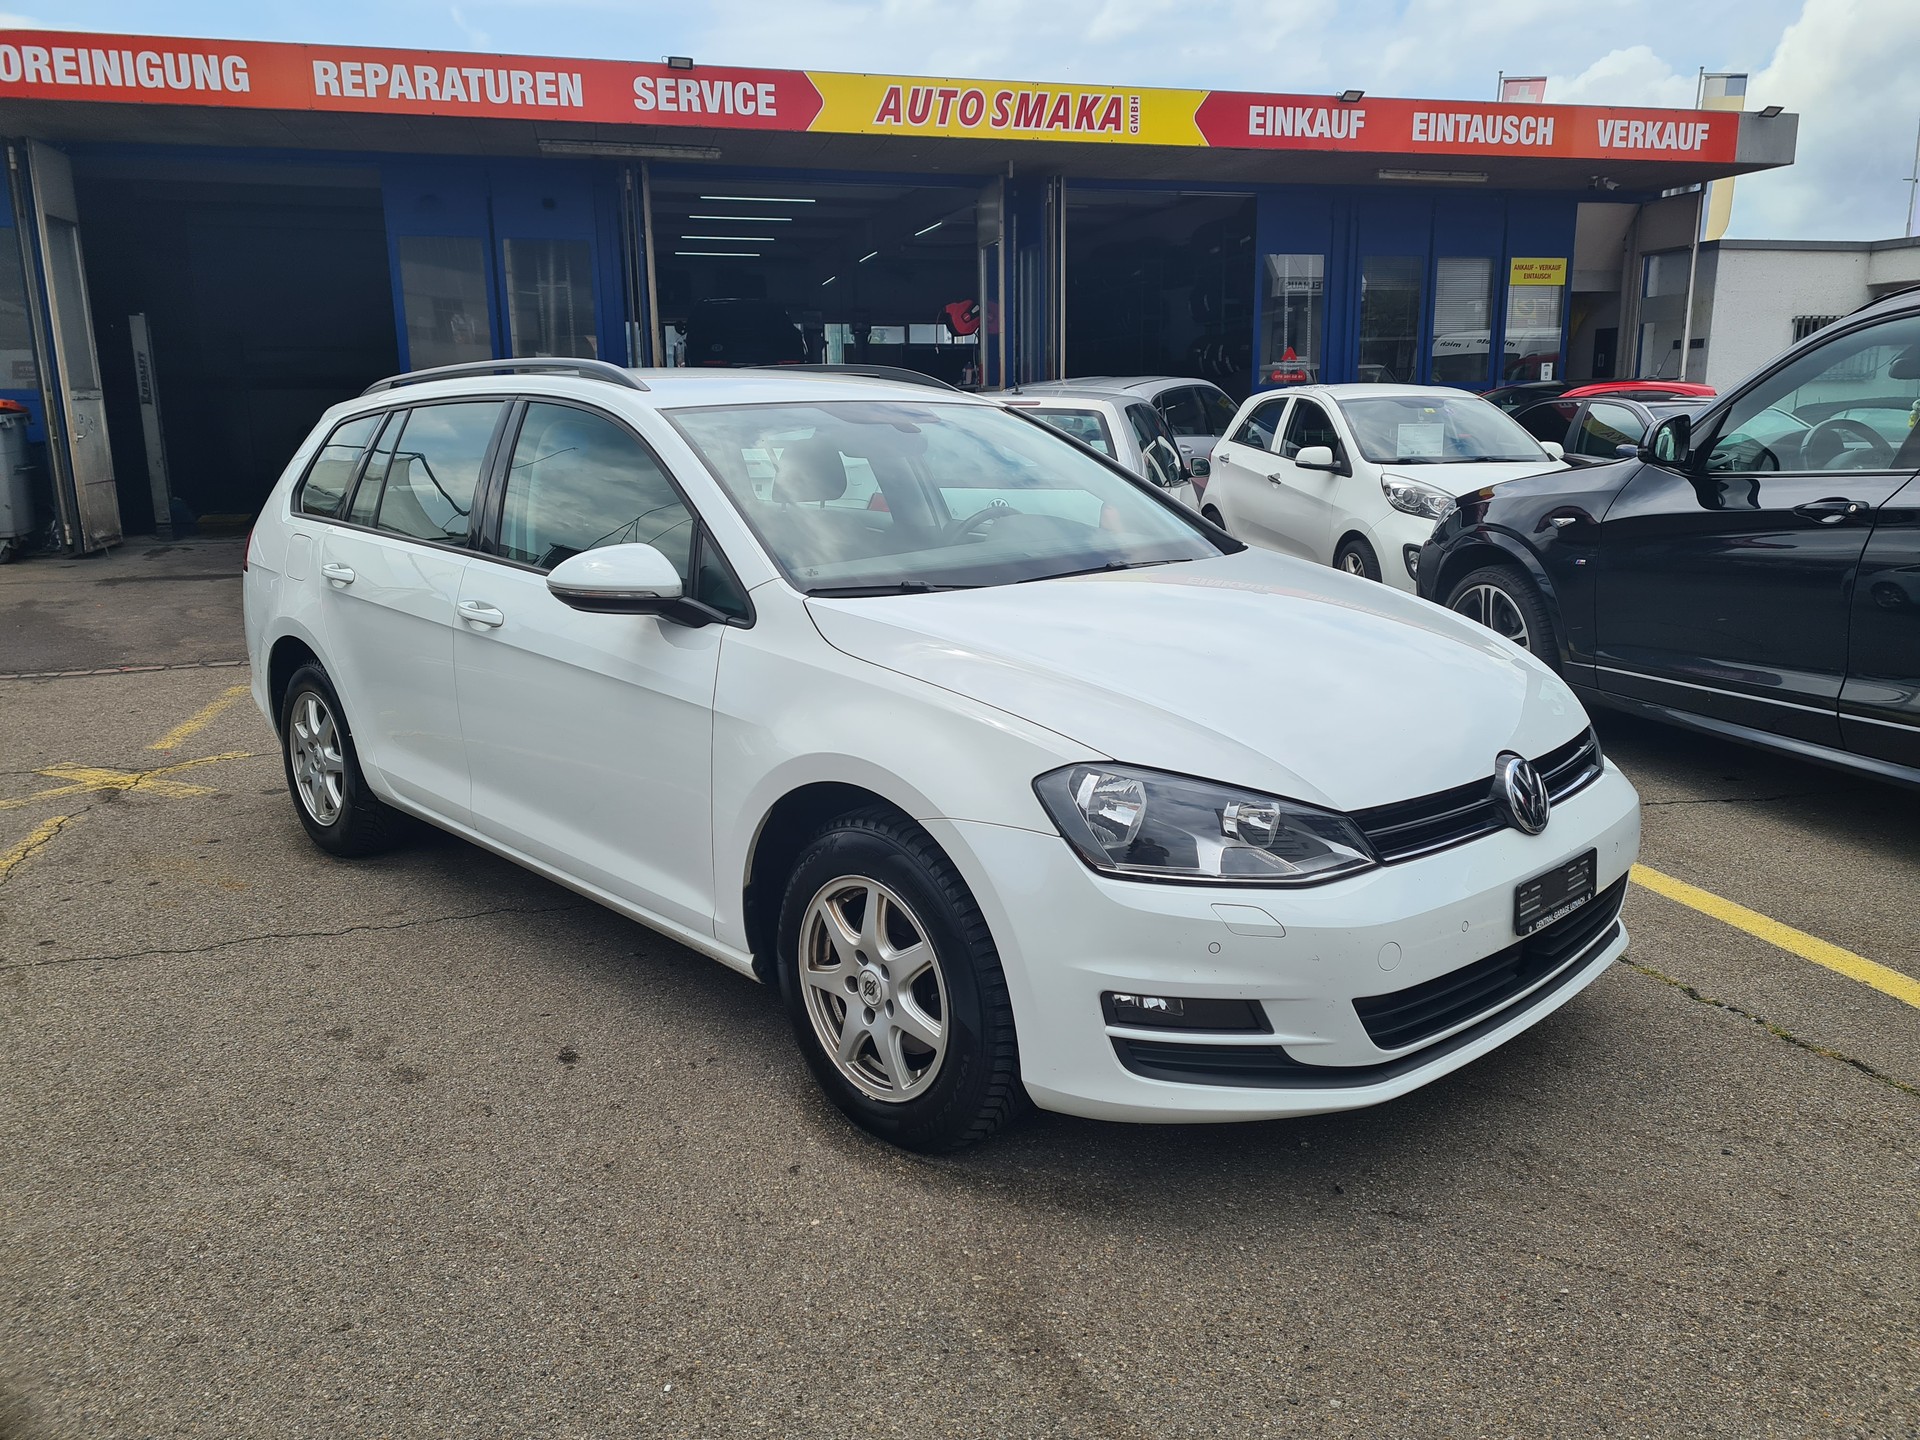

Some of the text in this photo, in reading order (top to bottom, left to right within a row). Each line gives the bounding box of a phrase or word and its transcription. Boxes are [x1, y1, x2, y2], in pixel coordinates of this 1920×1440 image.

[0, 44, 250, 93] OREINIGUNG
[313, 60, 584, 107] REPARATUREN
[633, 76, 777, 117] SERVICE
[875, 86, 1122, 132] AUTO SMAKA
[1130, 96, 1139, 134] GMBH
[1248, 105, 1366, 139] EINKAUF
[1412, 111, 1555, 146] EINTAUSCH
[1597, 119, 1710, 151] VERKAUF
